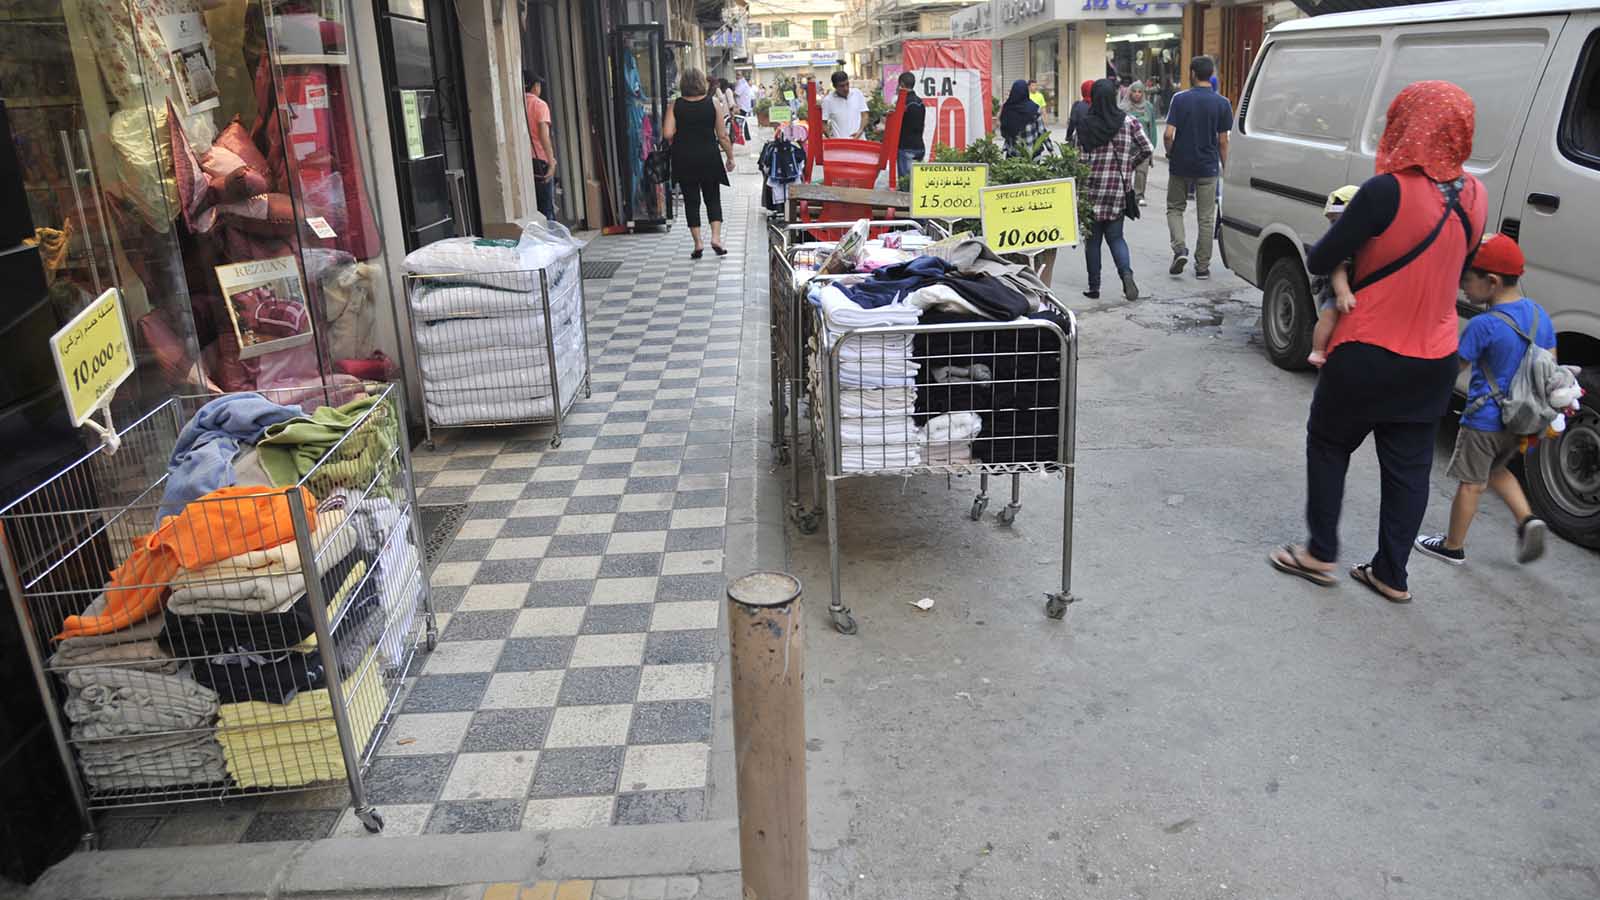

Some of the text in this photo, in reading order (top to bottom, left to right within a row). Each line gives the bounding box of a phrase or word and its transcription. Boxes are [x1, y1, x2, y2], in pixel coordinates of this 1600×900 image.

[995, 187, 1057, 200] SPECIAL PRICE
[998, 228, 1060, 248] 10,000
